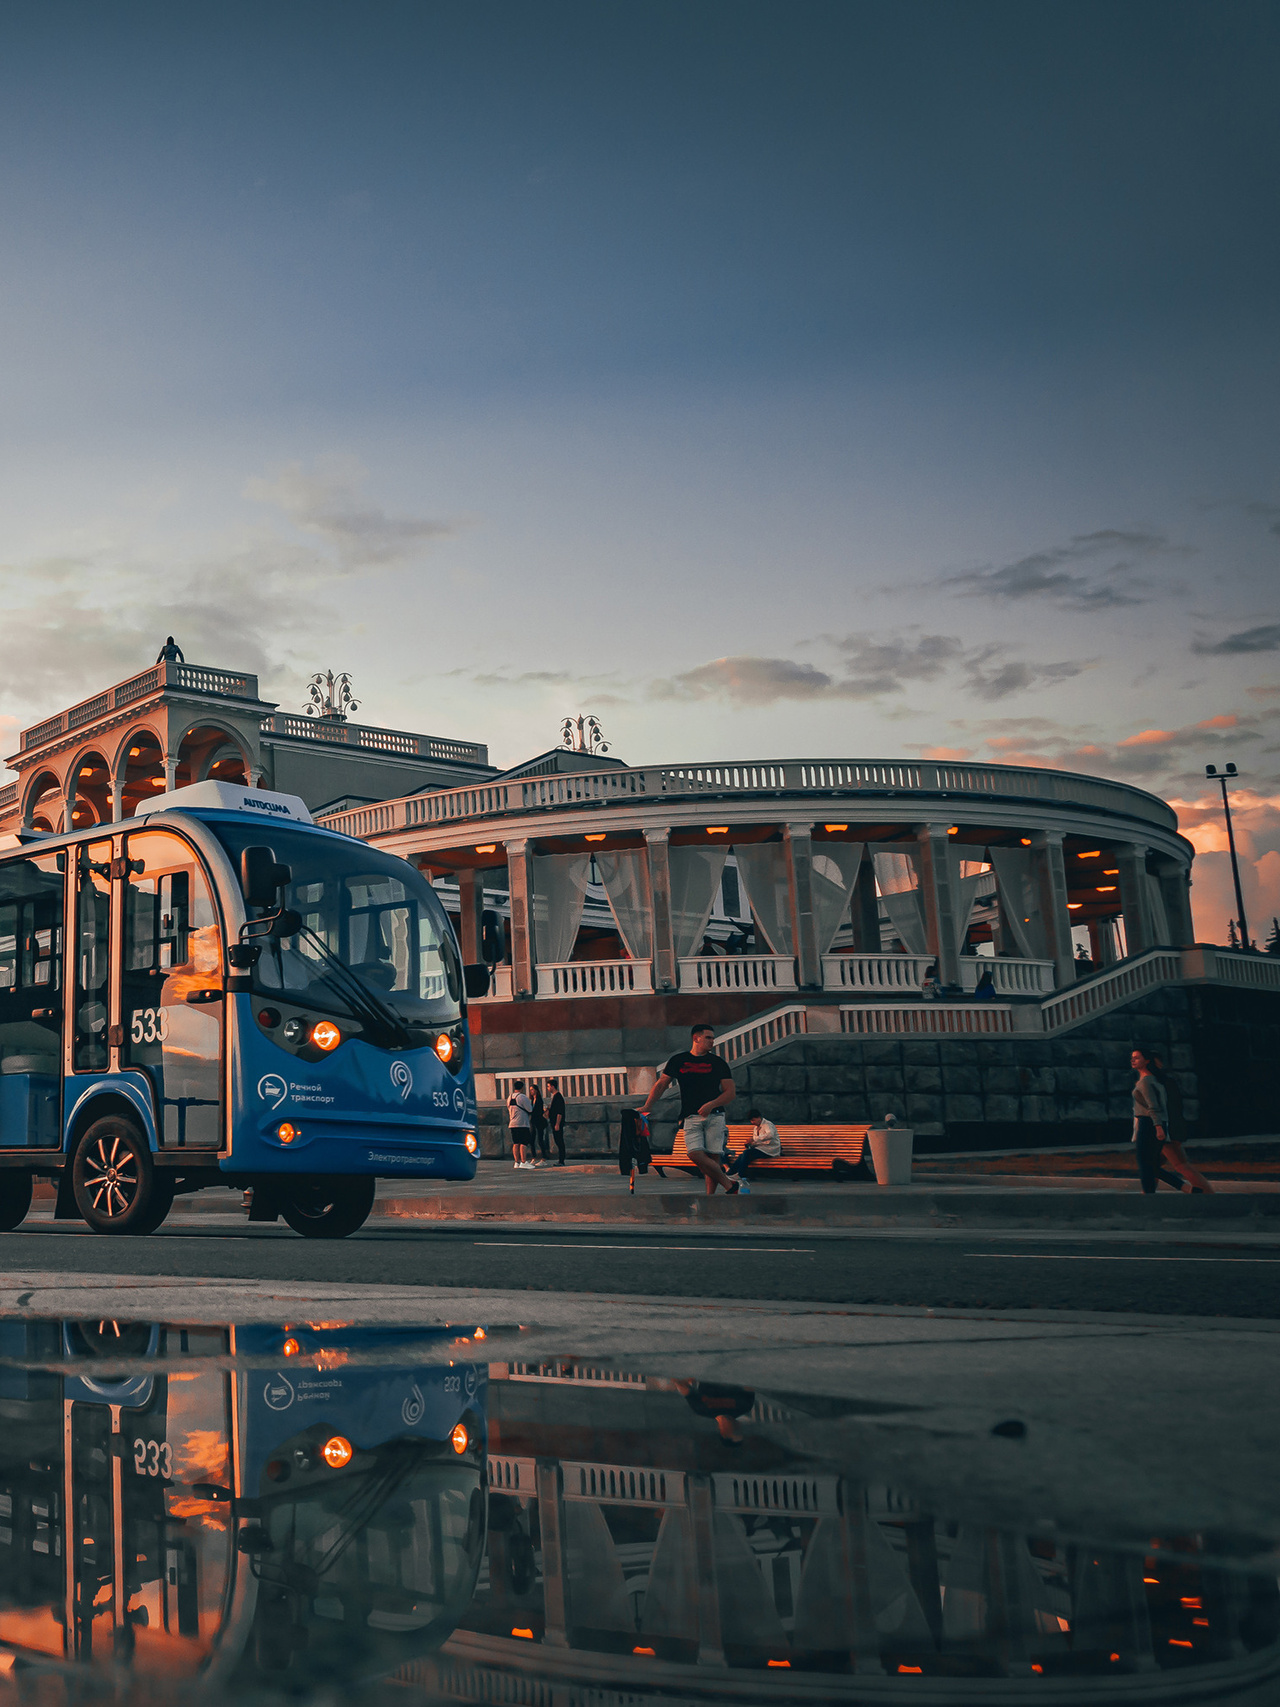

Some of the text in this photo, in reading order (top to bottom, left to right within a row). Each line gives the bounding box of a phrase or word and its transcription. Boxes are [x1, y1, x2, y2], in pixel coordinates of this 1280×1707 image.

[131, 1006, 169, 1044] 533
[289, 1082, 322, 1092] Речной
[290, 1094, 335, 1104] транспорт
[432, 1091, 449, 1107] 533
